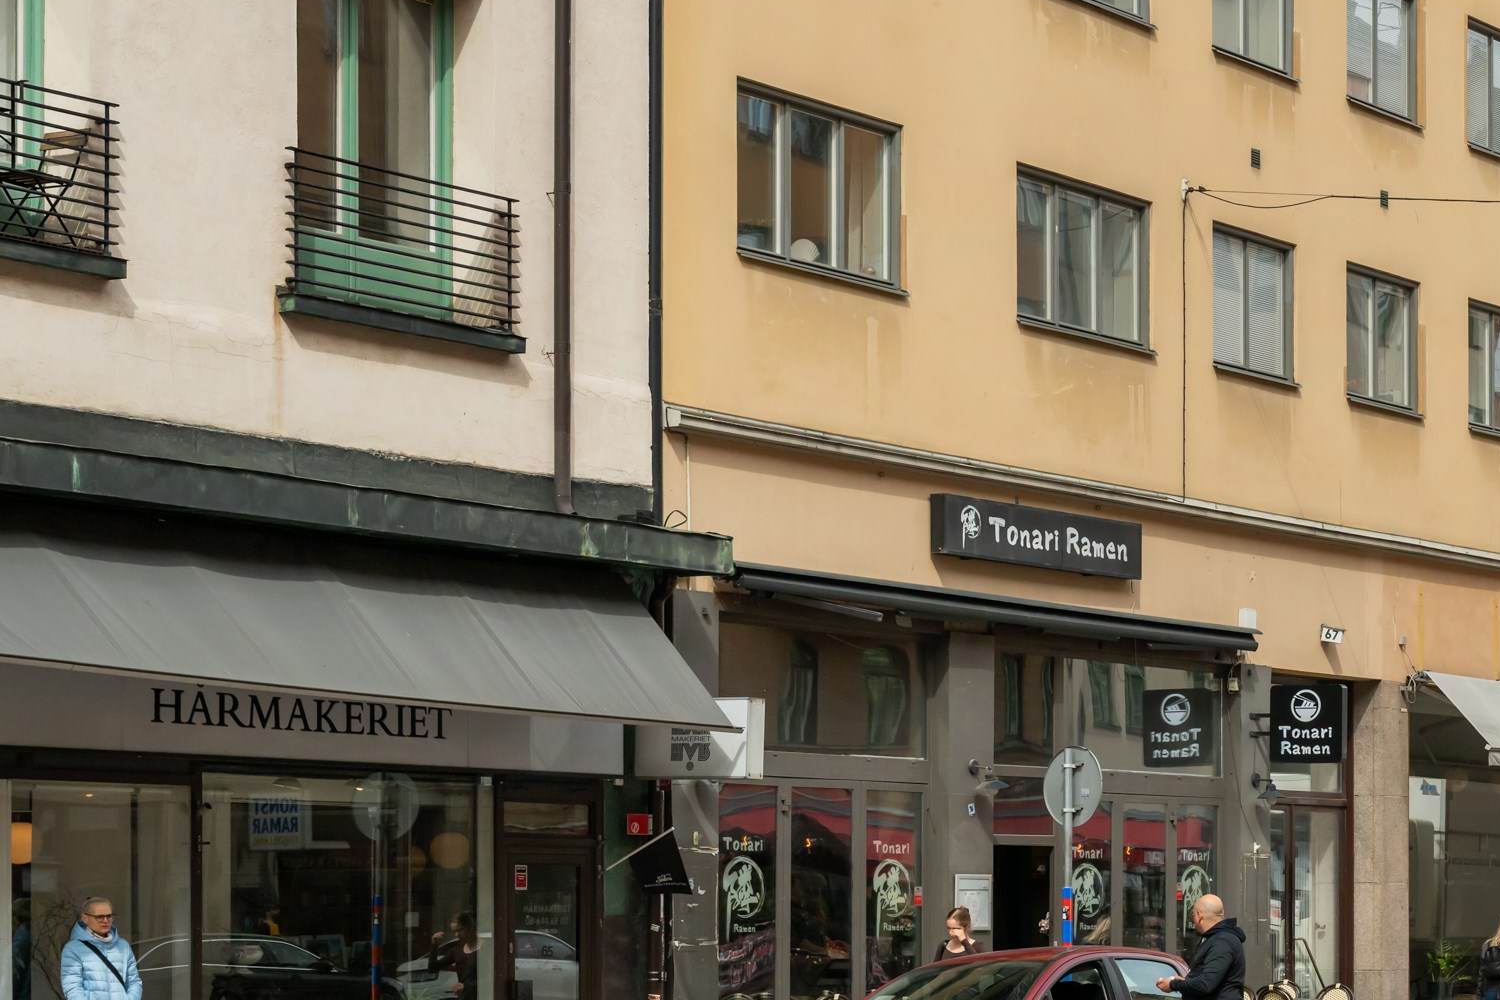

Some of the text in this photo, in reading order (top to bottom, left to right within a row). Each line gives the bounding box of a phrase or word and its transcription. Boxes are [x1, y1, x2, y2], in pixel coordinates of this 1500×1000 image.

[988, 516, 1128, 562] Tonari Ramen
[1325, 629, 1339, 640] 67
[151, 684, 452, 739] HÅRMAKERIET
[1278, 725, 1333, 739] Tonari
[1280, 740, 1331, 755] Ramen
[723, 835, 764, 851] Tonari
[873, 839, 910, 854] Tonari
[1072, 846, 1103, 859] Tonari
[1181, 849, 1210, 862] Tonari
[733, 923, 756, 933] Ramen
[883, 922, 904, 931] Ramen
[541, 945, 553, 957] 65
